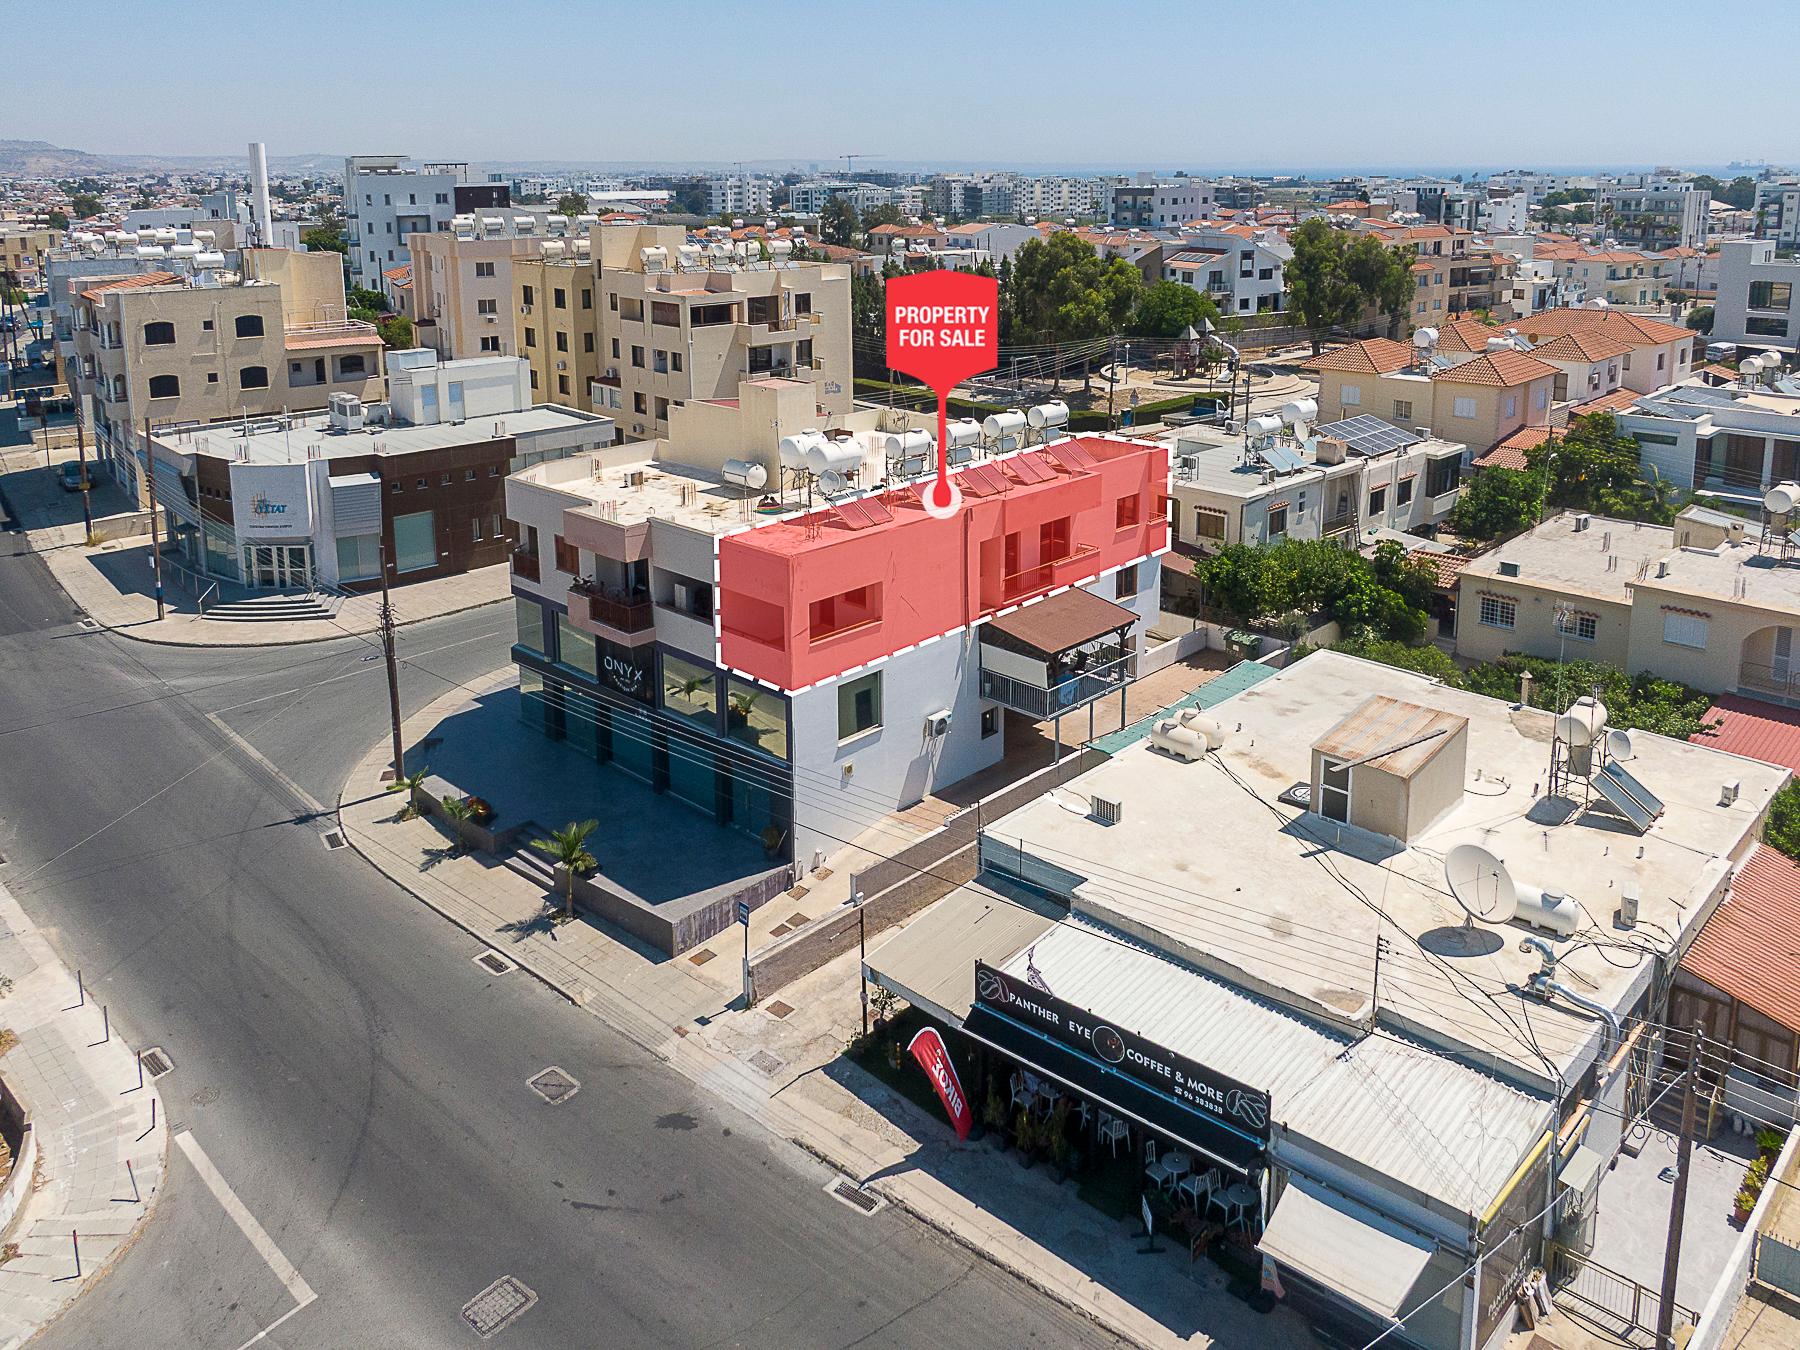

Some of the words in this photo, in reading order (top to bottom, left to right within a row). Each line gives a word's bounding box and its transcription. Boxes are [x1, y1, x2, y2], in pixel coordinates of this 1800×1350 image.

[604, 656, 643, 681] ONYX
[1009, 992, 1060, 1025] PANTHER
[1068, 1020, 1091, 1040] EYE
[1126, 1048, 1172, 1078] COFFEE
[1174, 1070, 1185, 1084] &
[1187, 1077, 1224, 1103] MORE
[1183, 1090, 1193, 1101] 96
[1195, 1096, 1223, 1115] 383838
